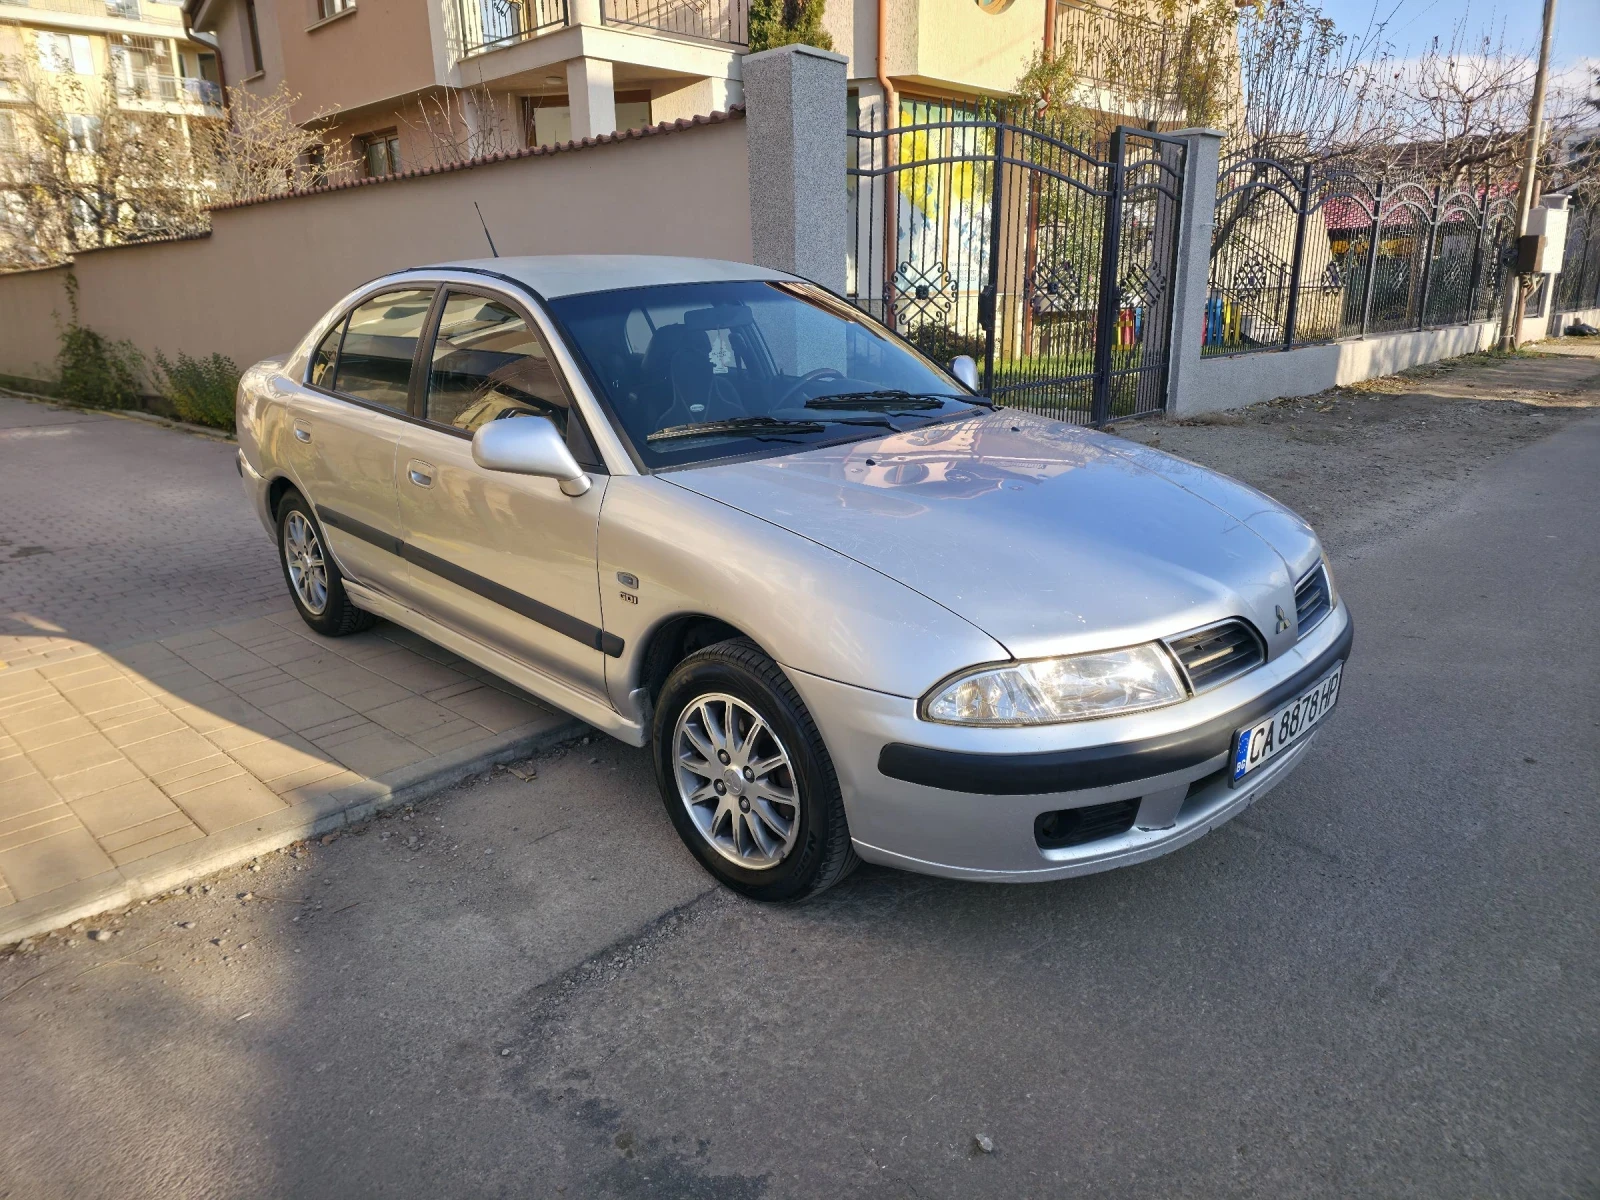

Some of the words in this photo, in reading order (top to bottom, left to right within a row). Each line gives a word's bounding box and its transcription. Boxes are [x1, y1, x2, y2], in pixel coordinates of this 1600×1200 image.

[1250, 720, 1275, 763] CA
[1279, 690, 1319, 745] 8878
[1318, 672, 1338, 714] HP
[1236, 759, 1246, 773] BG
